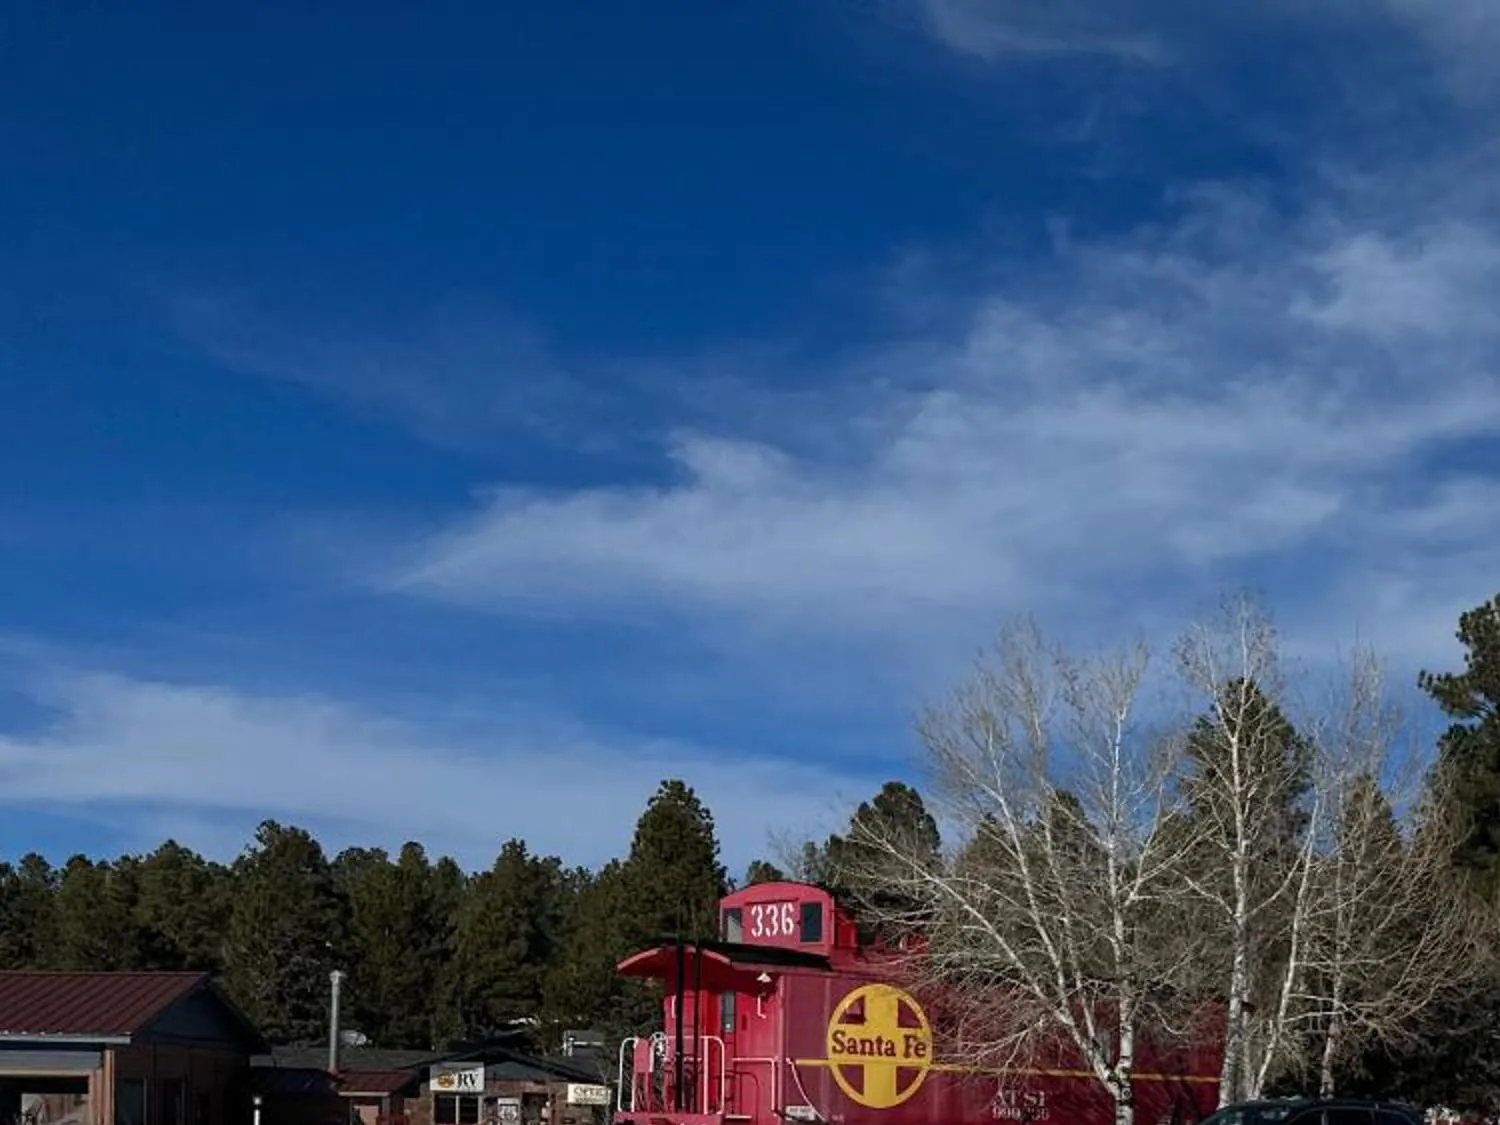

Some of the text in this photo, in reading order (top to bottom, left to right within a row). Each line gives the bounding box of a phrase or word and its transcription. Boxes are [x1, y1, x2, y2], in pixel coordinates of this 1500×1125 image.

[751, 903, 795, 938] 336
[832, 1029, 927, 1059] Santa Fe
[457, 1072, 479, 1088] RV
